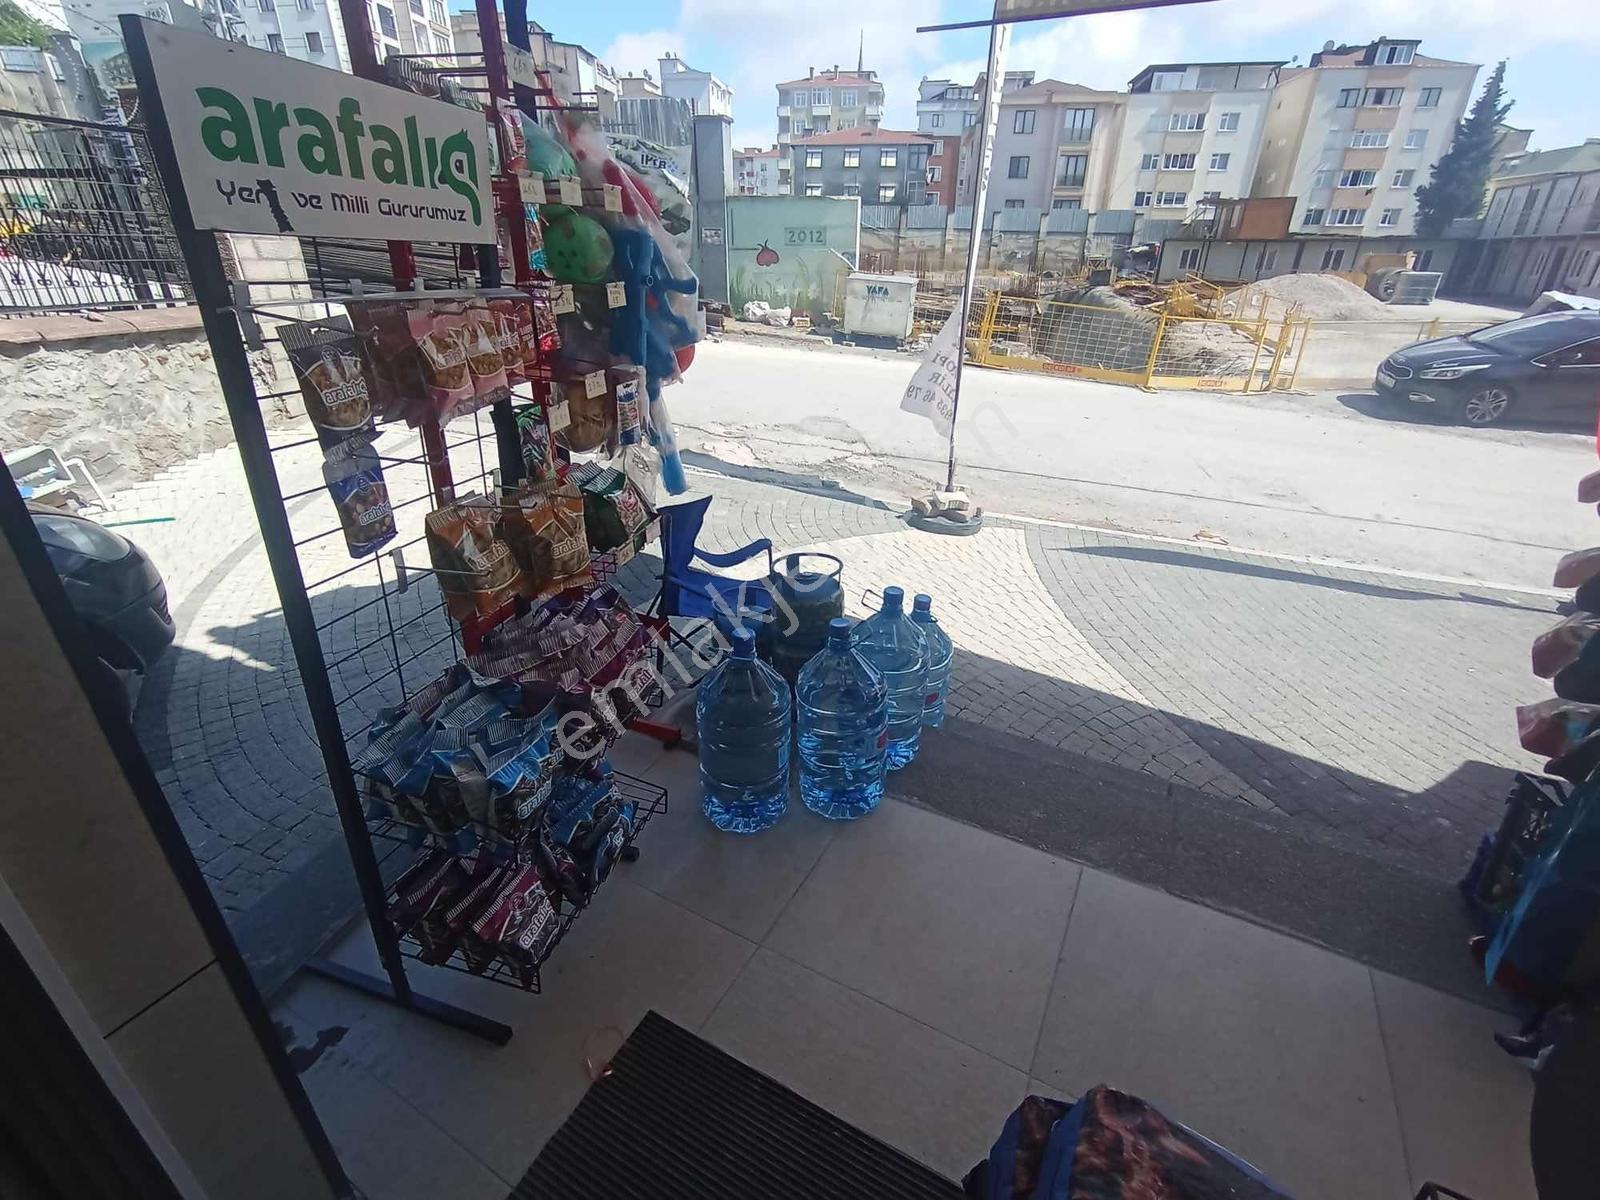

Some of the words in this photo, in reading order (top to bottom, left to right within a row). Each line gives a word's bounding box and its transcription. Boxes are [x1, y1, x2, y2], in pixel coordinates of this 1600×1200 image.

[290, 190, 323, 211] ve
[331, 191, 370, 215] Milli
[378, 198, 467, 223] Gururumuz
[788, 230, 824, 243] 2012
